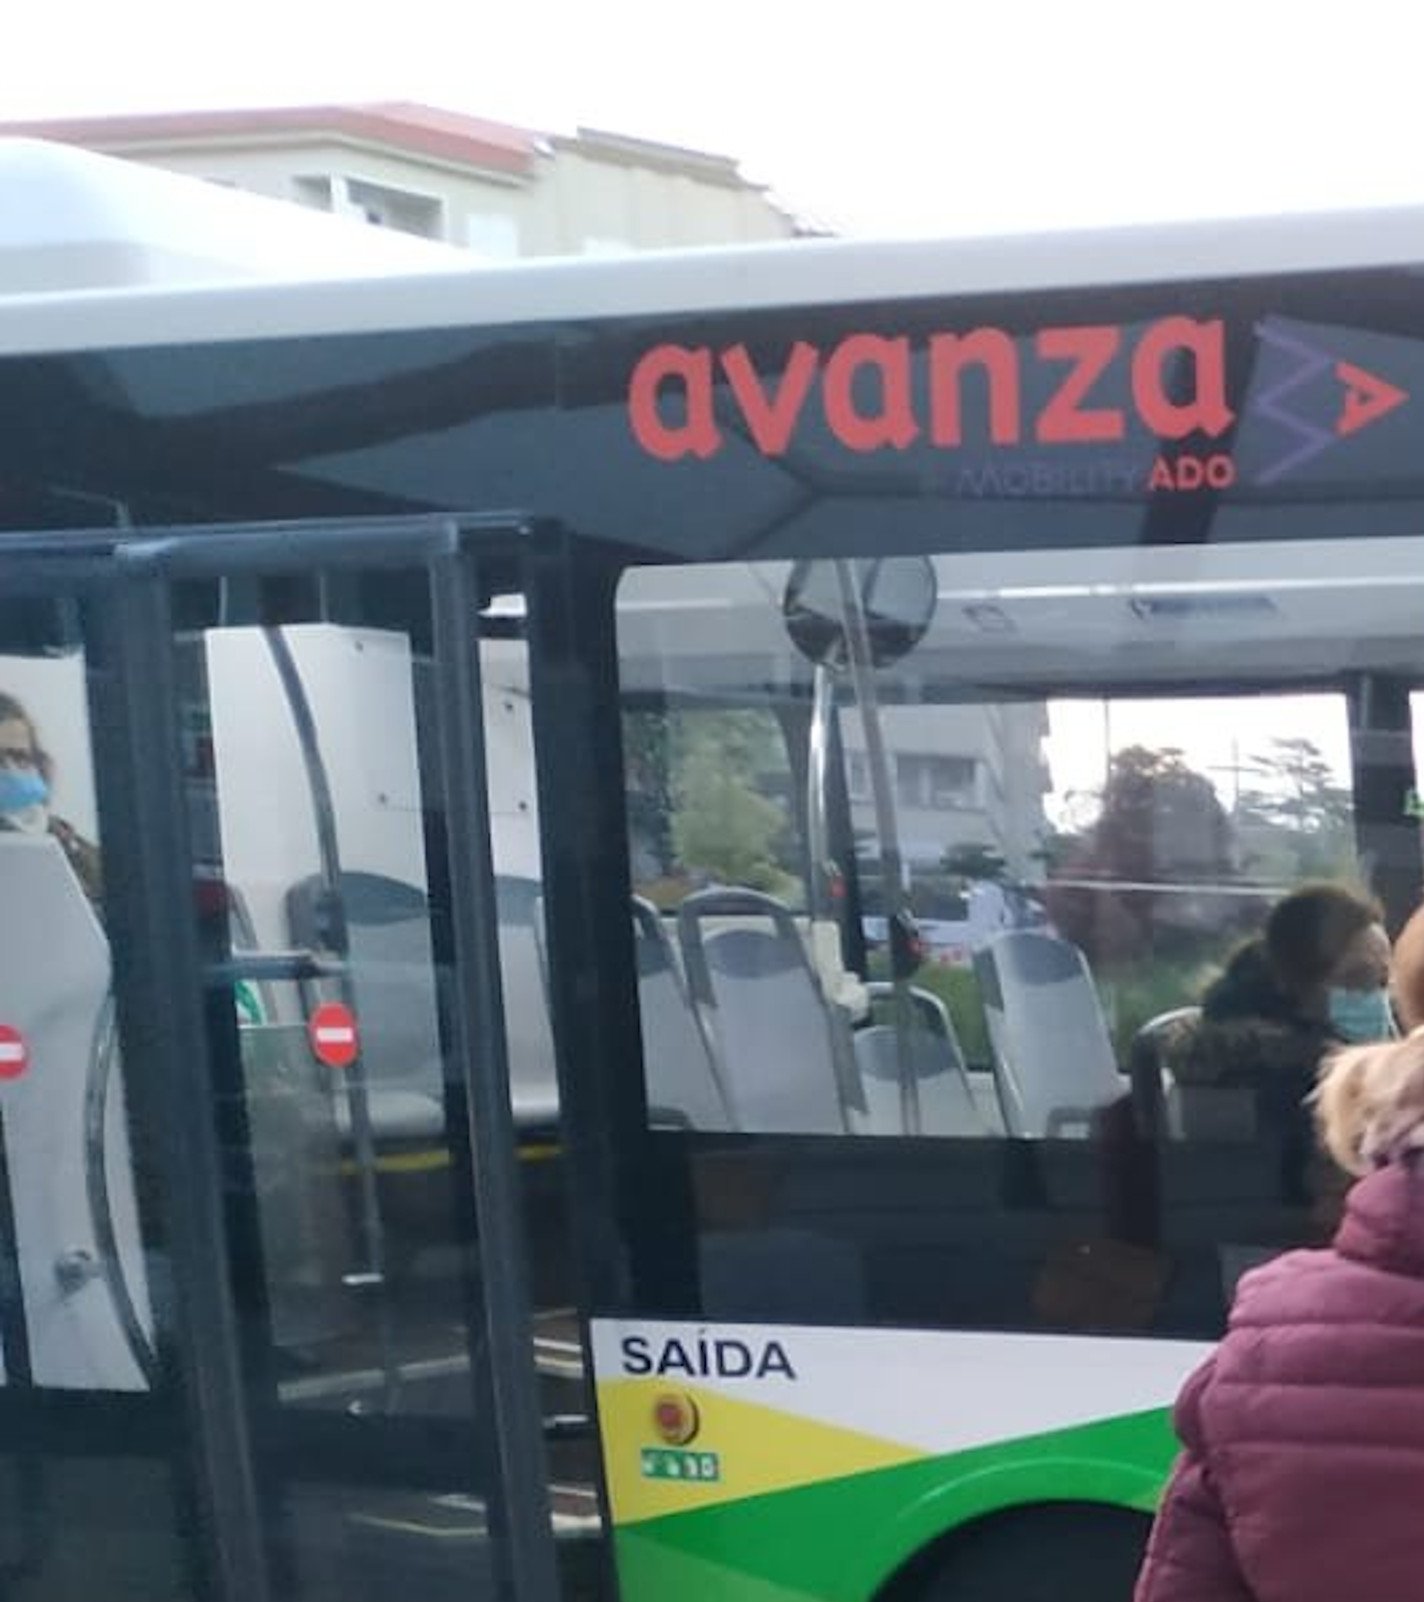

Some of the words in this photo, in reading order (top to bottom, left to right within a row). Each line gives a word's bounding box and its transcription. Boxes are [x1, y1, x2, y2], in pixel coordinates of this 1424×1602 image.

[626, 313, 1237, 462] avanza
[1147, 455, 1238, 491] ADO
[620, 1328, 797, 1381] SAÍDA
